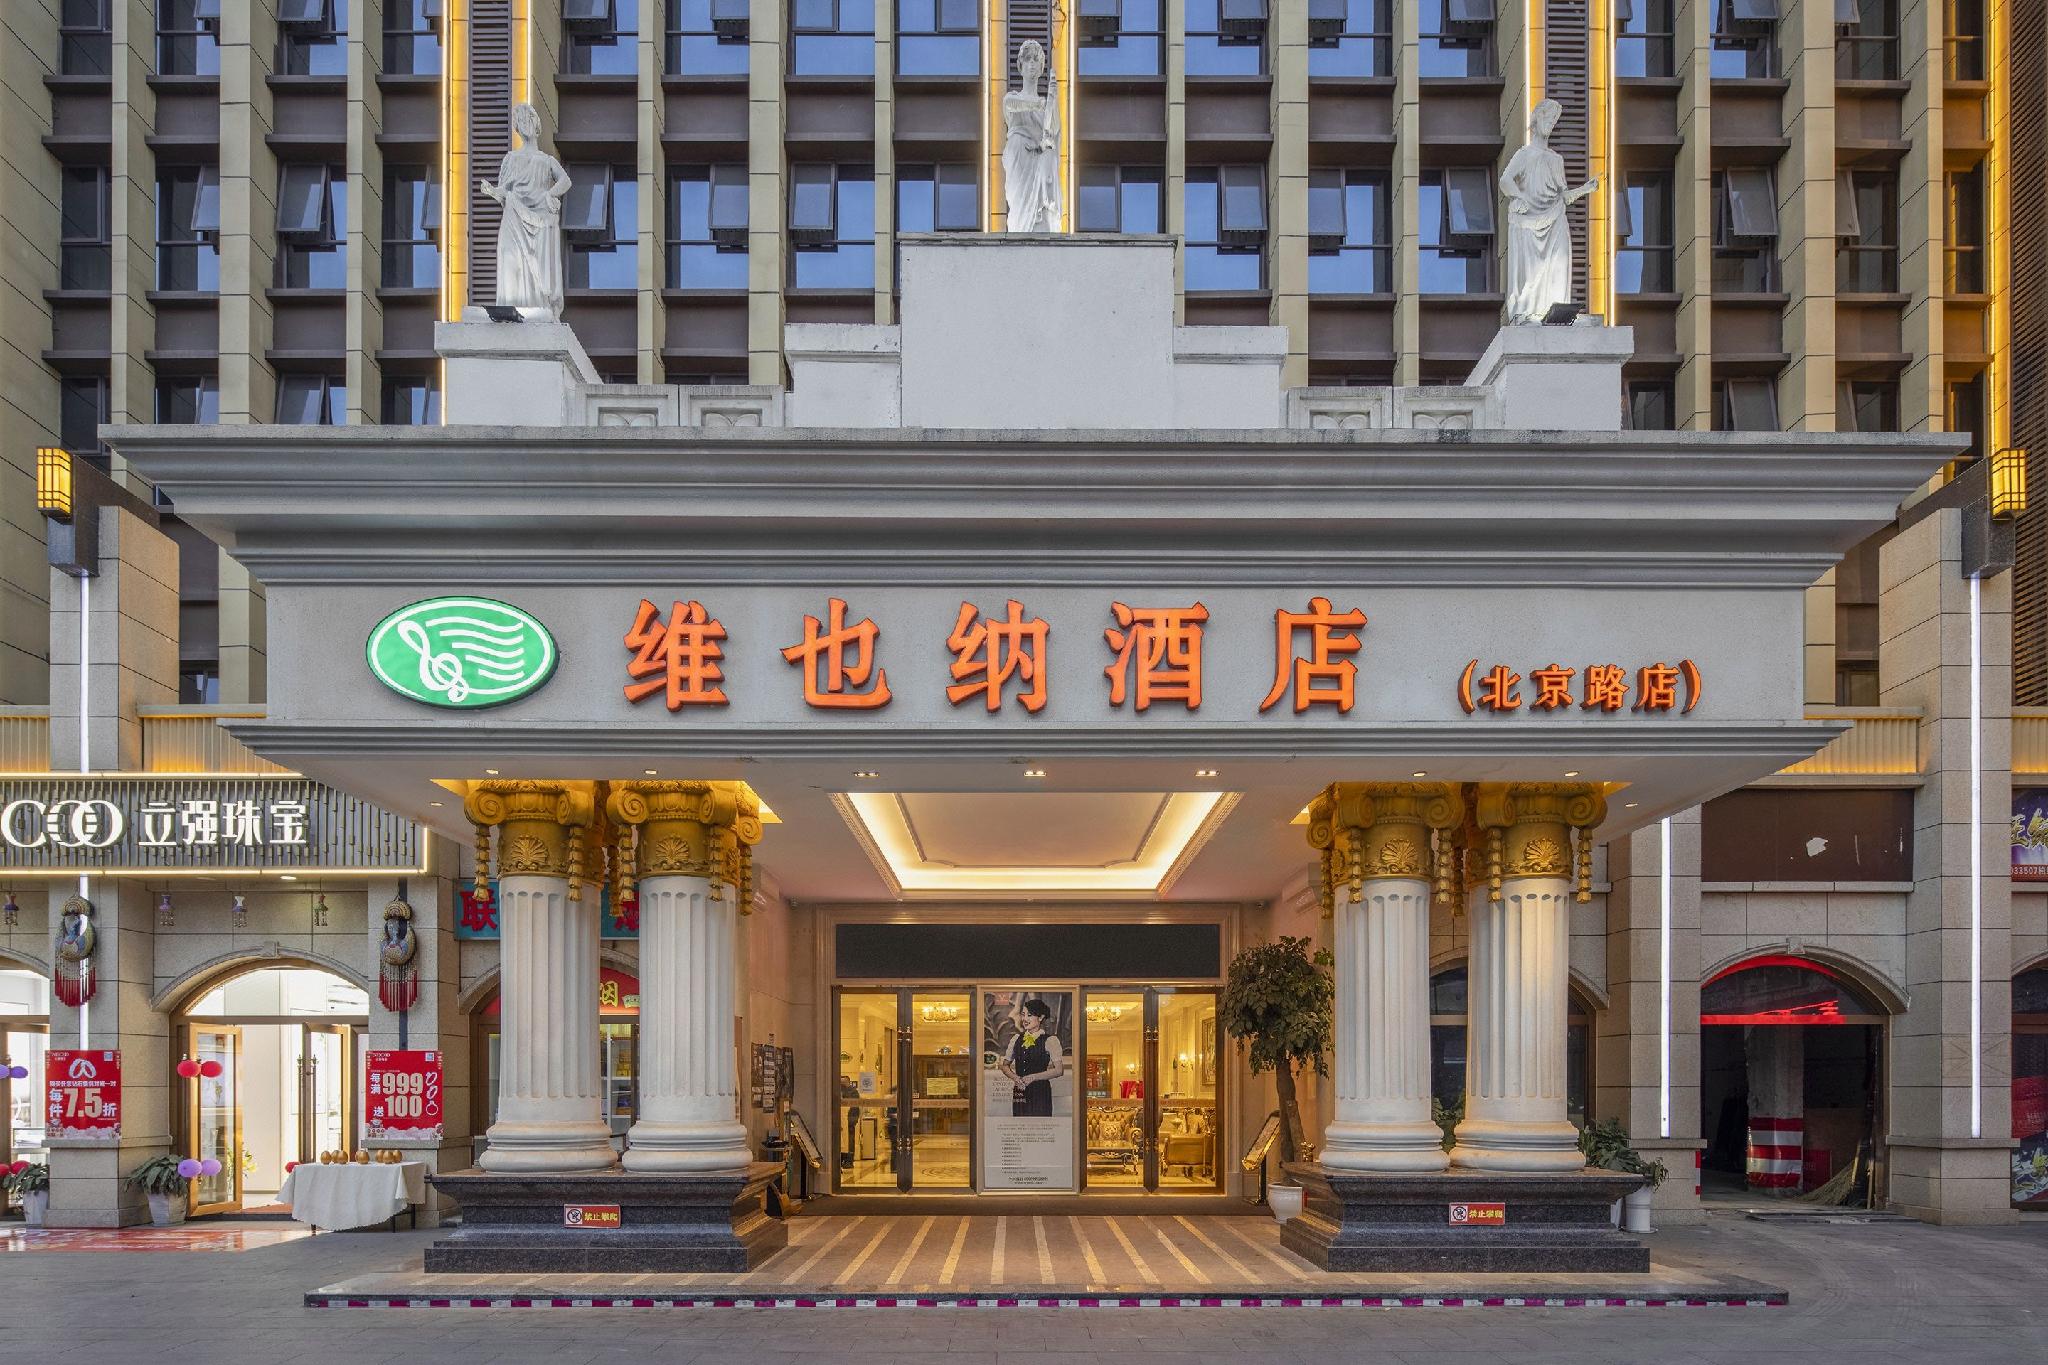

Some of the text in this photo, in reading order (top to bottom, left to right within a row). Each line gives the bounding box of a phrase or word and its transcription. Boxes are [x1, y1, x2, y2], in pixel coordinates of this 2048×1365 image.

[623, 597, 1367, 714] 维也纳酒店
[138, 800, 307, 846] 立强珠宝
[382, 1073, 423, 1095] 999
